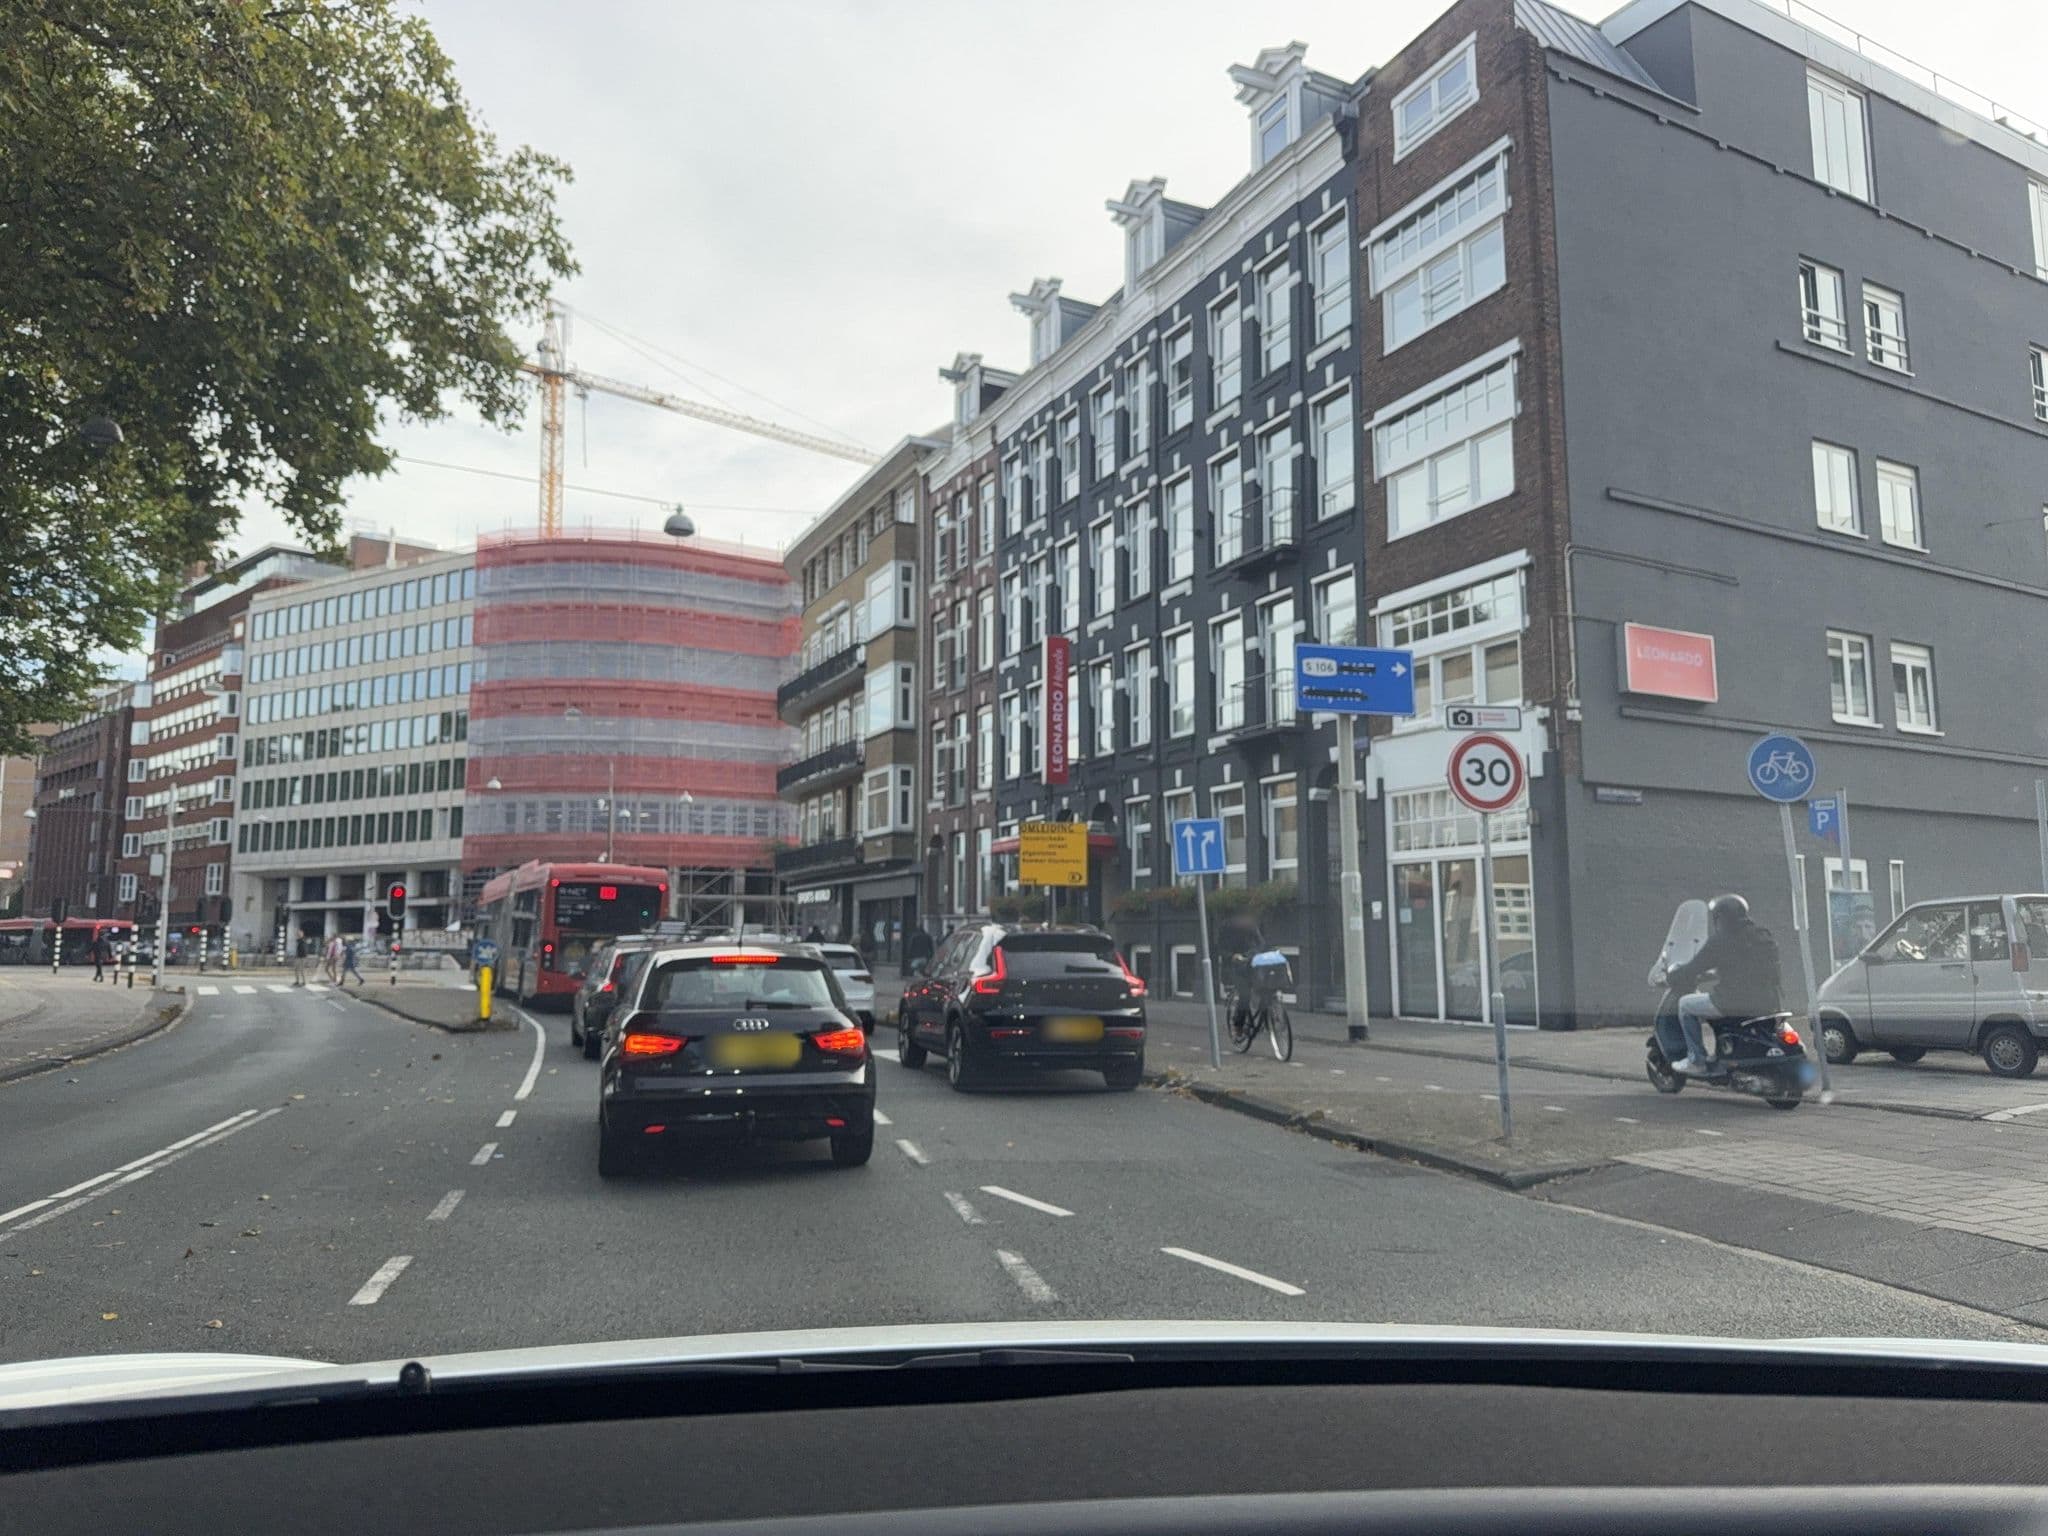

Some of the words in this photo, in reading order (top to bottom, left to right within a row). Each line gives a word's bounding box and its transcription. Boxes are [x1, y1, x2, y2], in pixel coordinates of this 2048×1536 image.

[1305, 662, 1313, 672] S
[1315, 662, 1335, 673] 106
[1052, 690, 1064, 773] LEONARDO
[1466, 758, 1510, 787] 30
[1021, 823, 1075, 833] OMLEIDING
[1816, 811, 1830, 830] P
